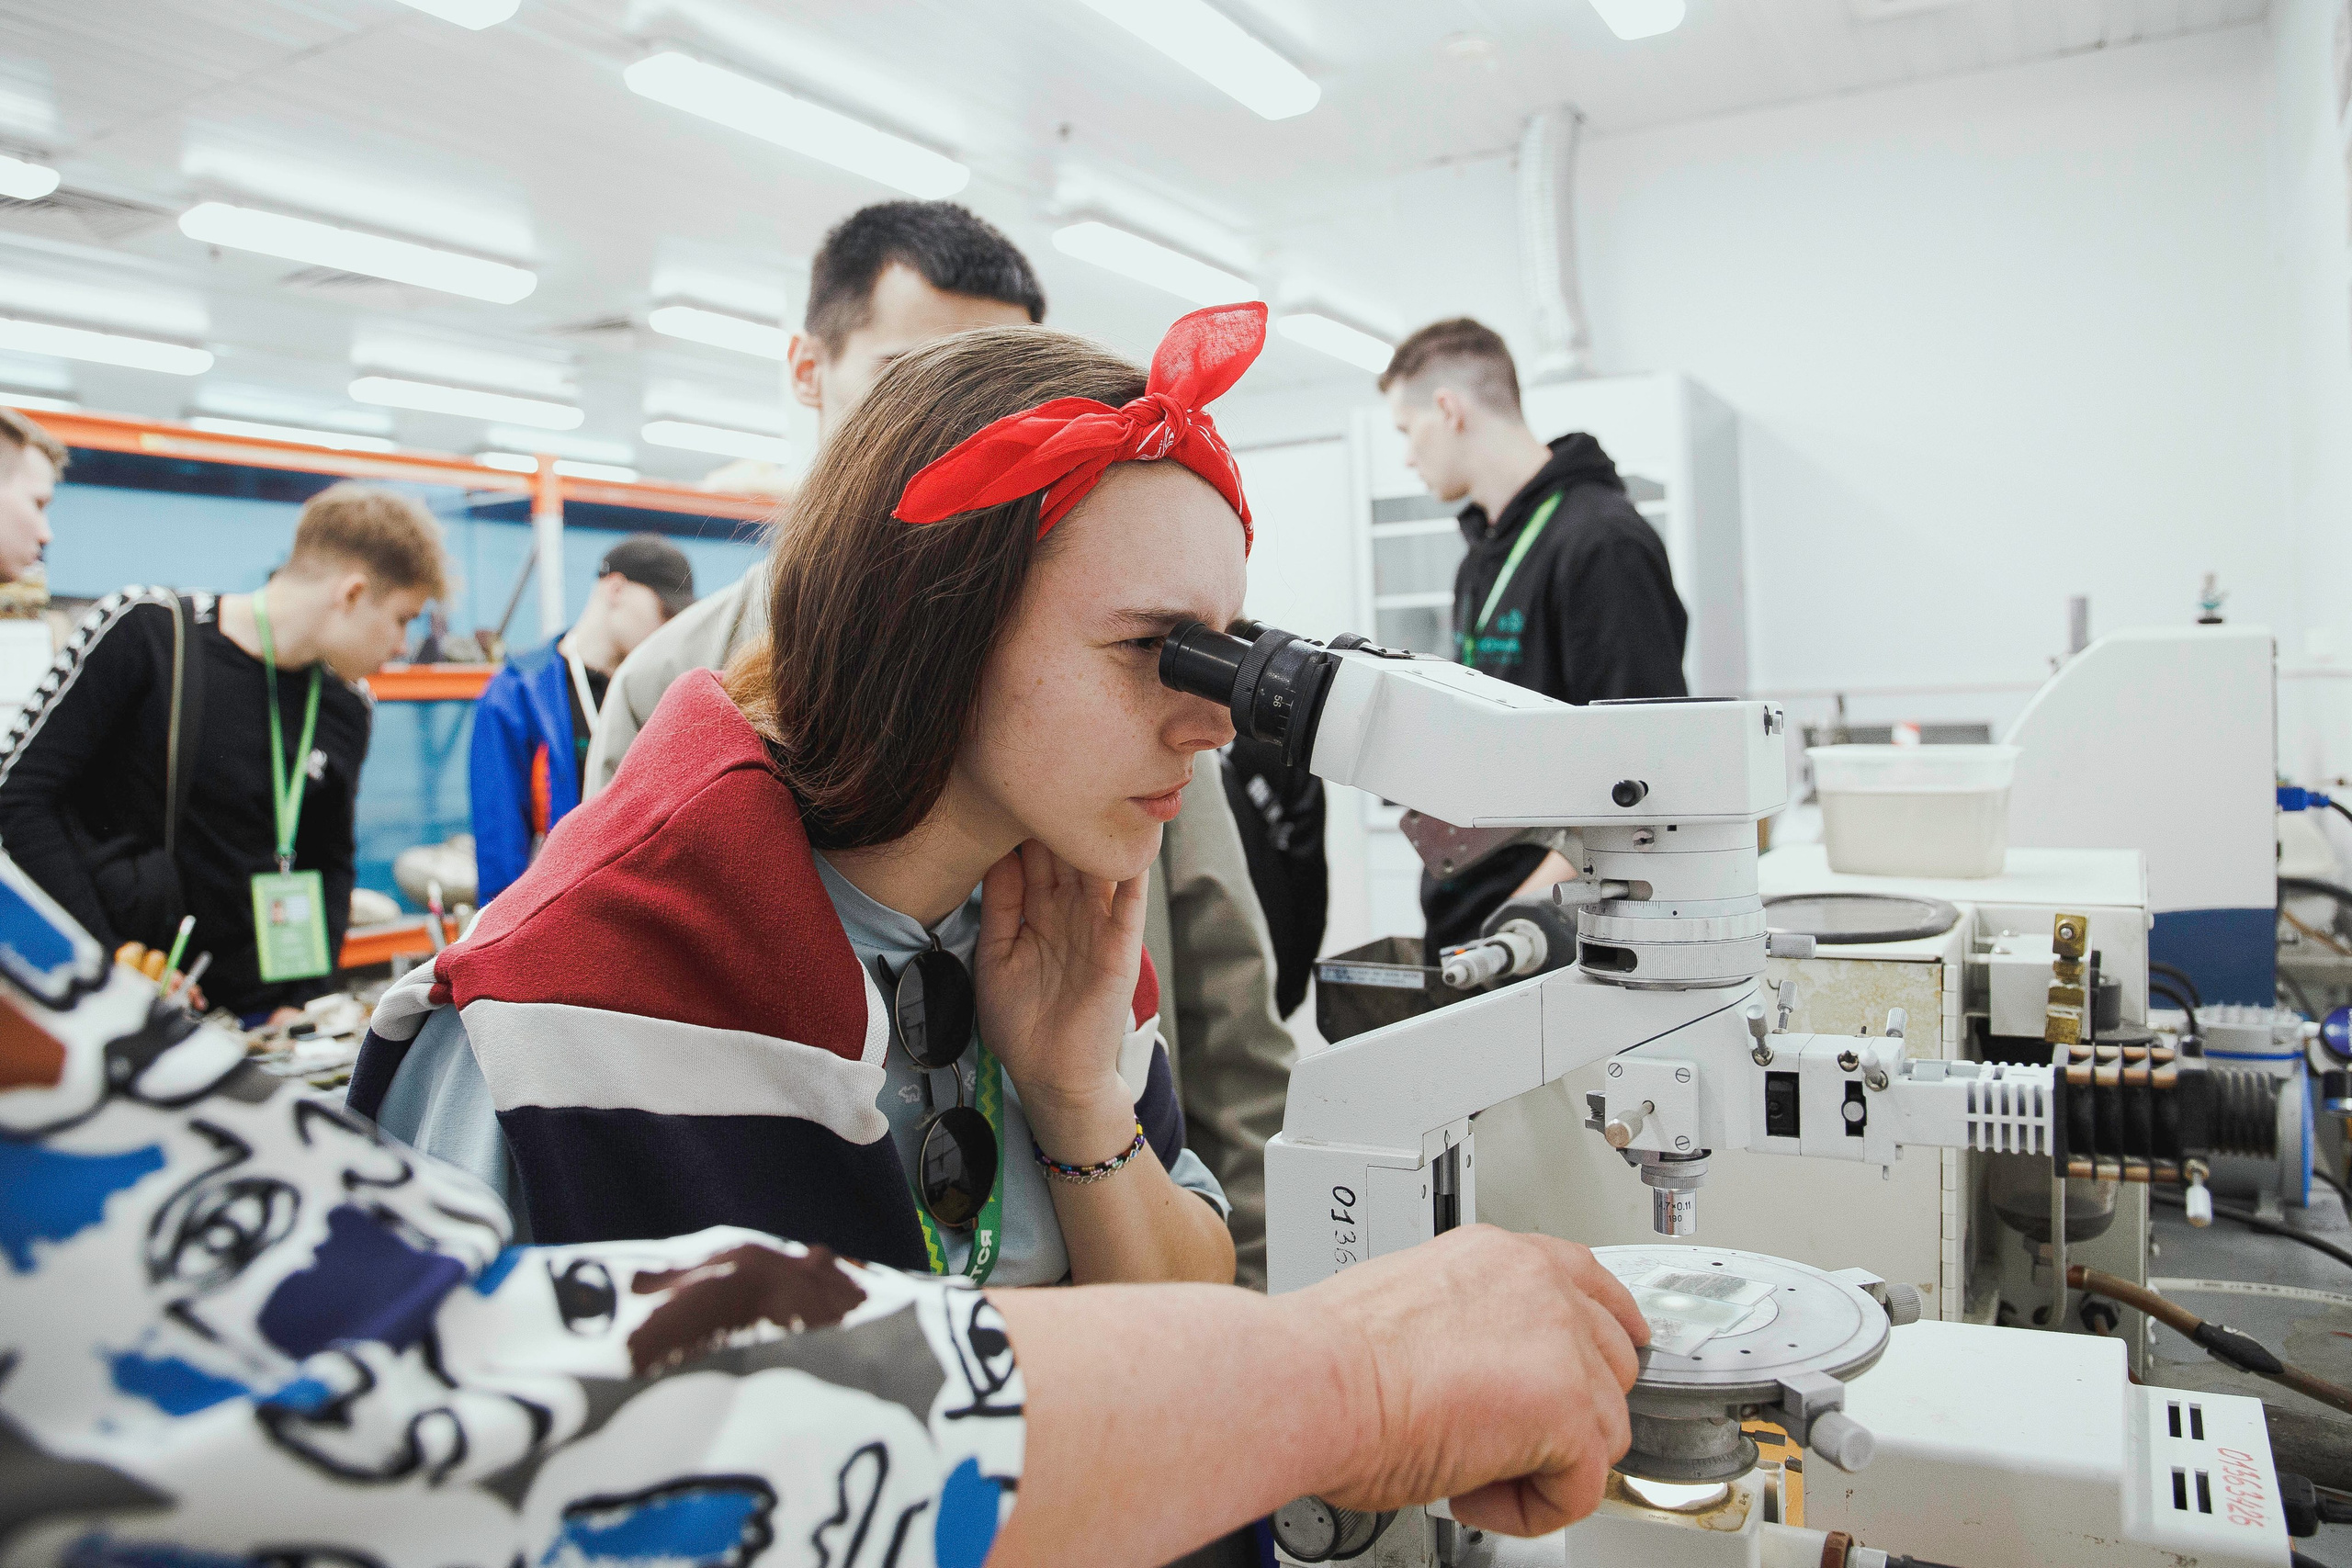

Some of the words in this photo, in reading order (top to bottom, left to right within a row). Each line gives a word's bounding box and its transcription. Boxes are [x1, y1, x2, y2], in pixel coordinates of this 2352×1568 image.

[1272, 694, 1283, 708] 56
[968, 1229, 993, 1286] ТСЯ
[1330, 1185, 1357, 1274] 0136
